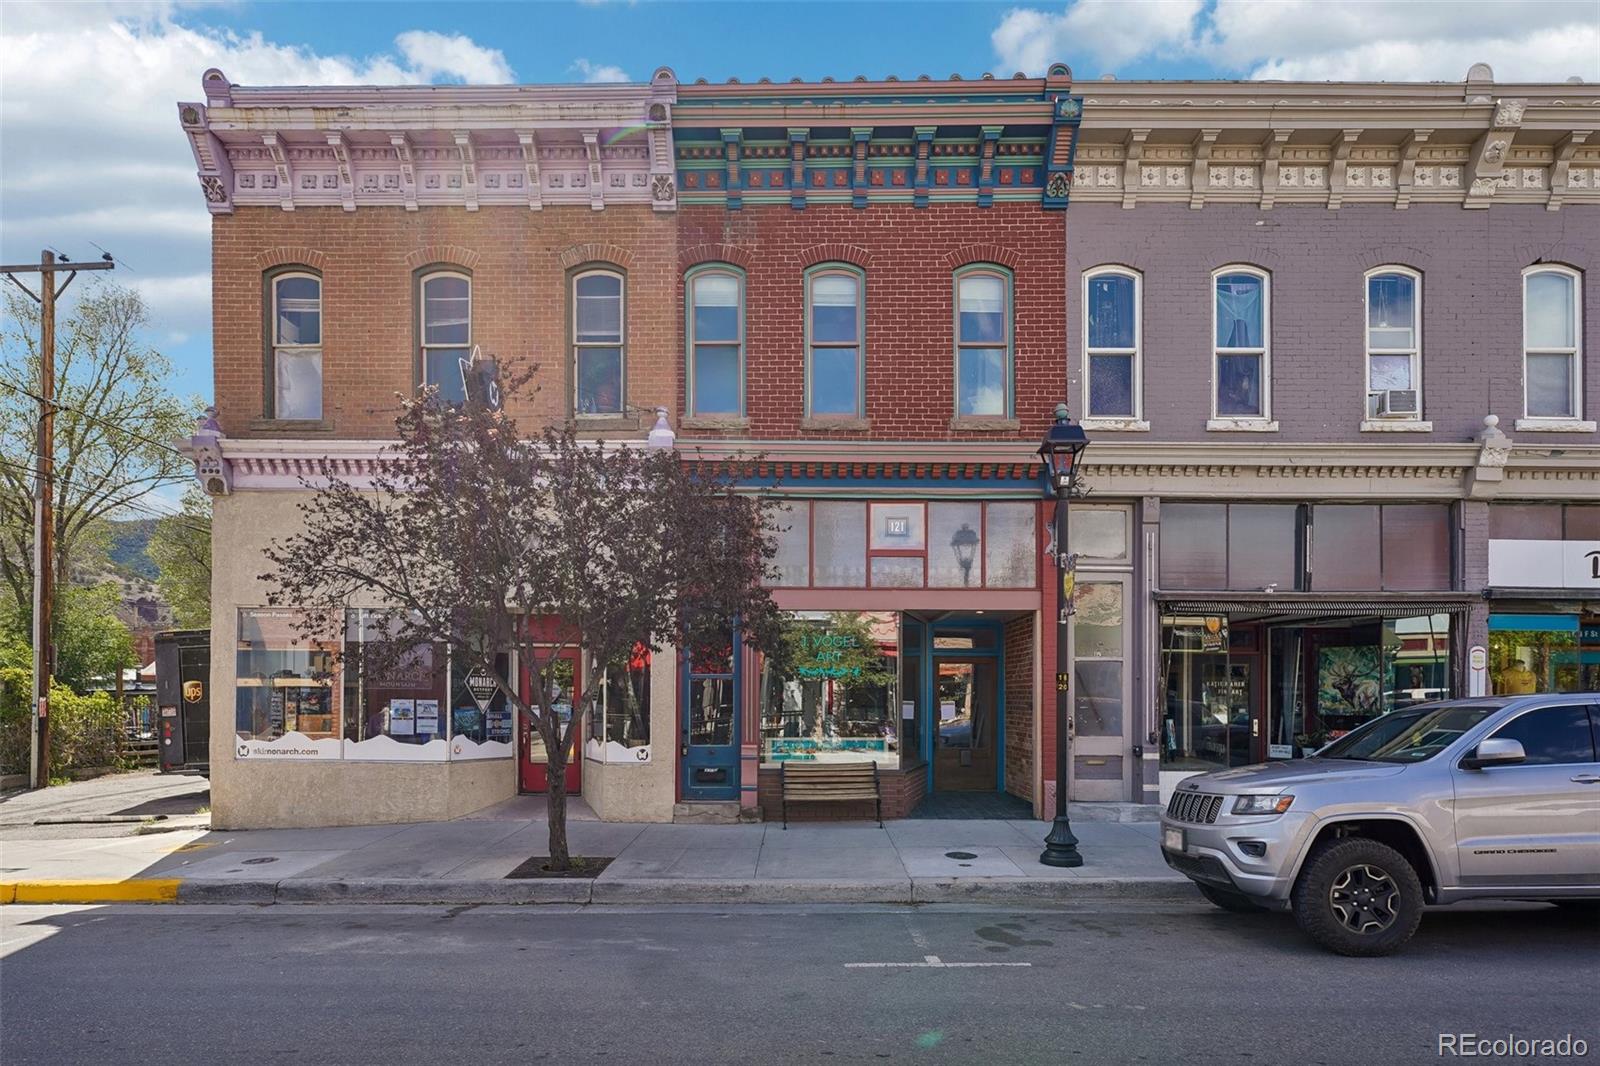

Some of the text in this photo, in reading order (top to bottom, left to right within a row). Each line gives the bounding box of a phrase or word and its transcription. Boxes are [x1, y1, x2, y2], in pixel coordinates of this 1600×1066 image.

[890, 521, 904, 532] 121
[813, 635, 861, 648] VOGEL
[816, 650, 842, 662] ART
[185, 687, 201, 700] ups
